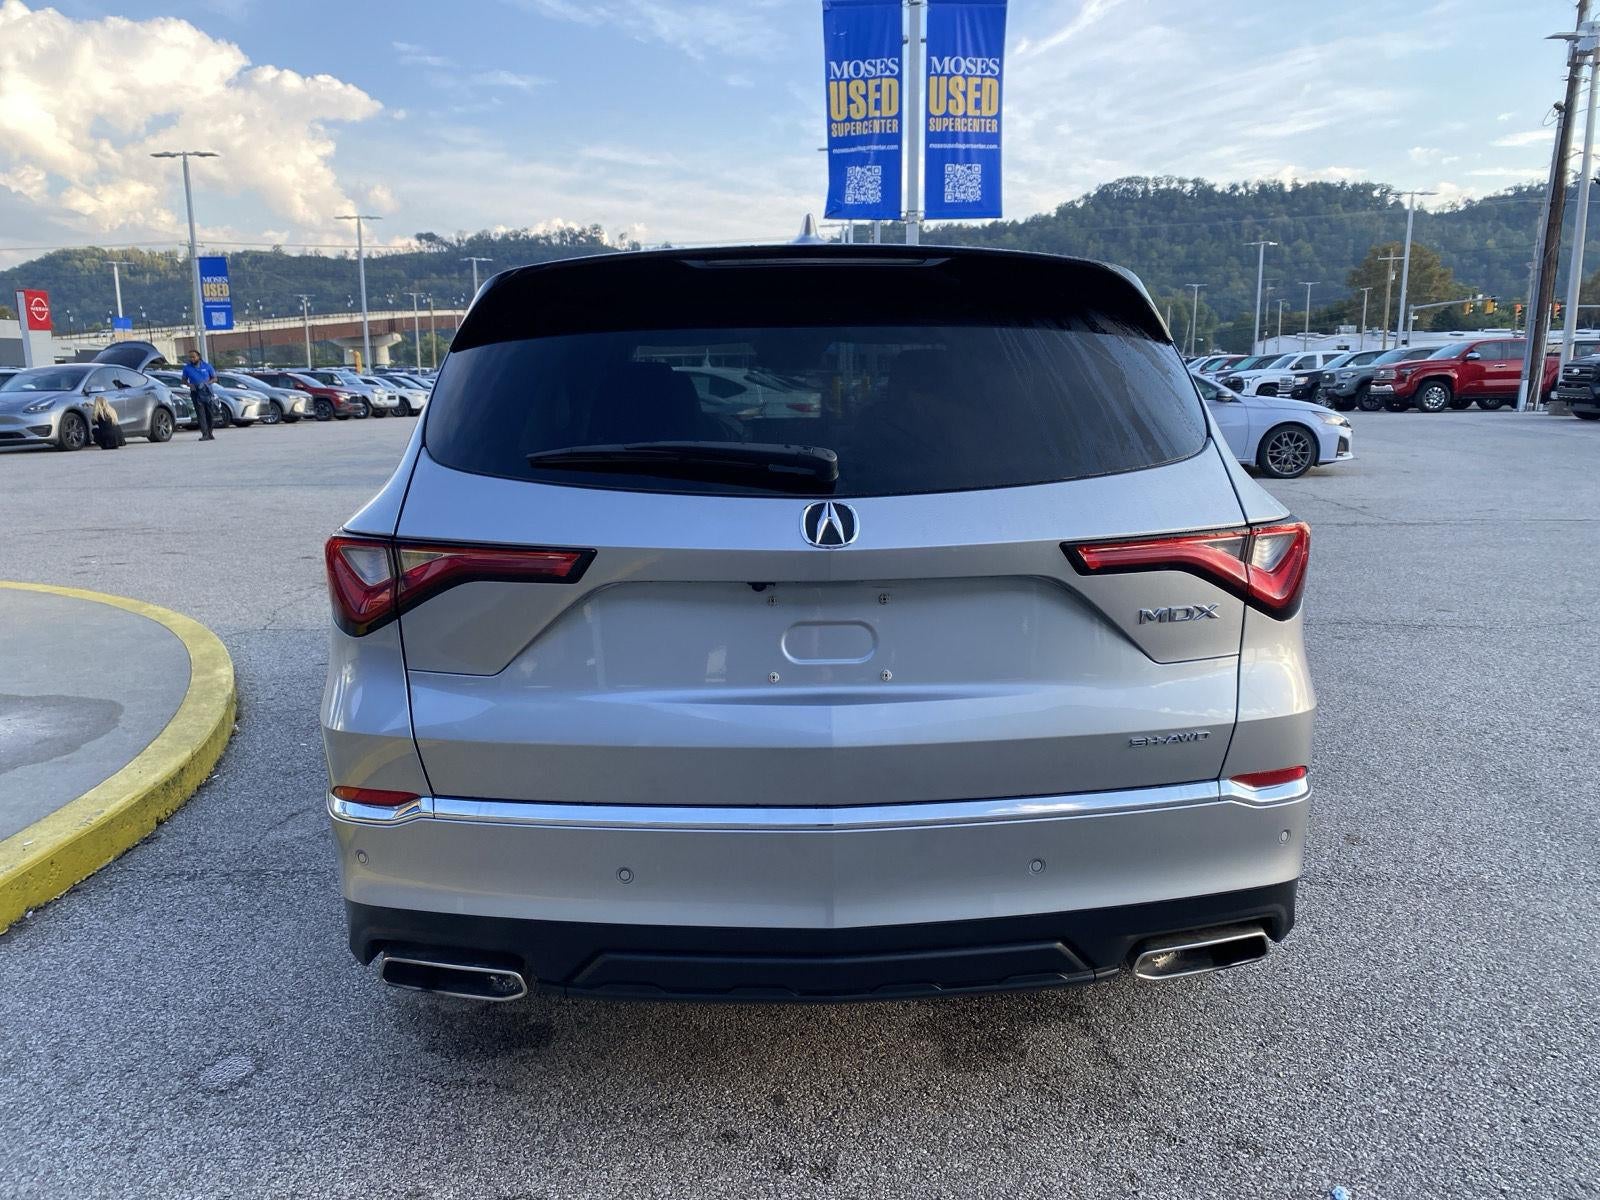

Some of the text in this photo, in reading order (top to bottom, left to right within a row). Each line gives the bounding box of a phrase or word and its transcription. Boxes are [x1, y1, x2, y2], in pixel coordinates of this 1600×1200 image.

[829, 58, 899, 79] MOSES
[929, 56, 1000, 76] MOSES
[829, 78, 899, 121] USED
[928, 76, 999, 116] USED
[831, 119, 899, 138] SUPERCENTER
[928, 117, 998, 133] SUPERCENTER
[203, 283, 230, 297] USED
[1138, 603, 1220, 624] MDX
